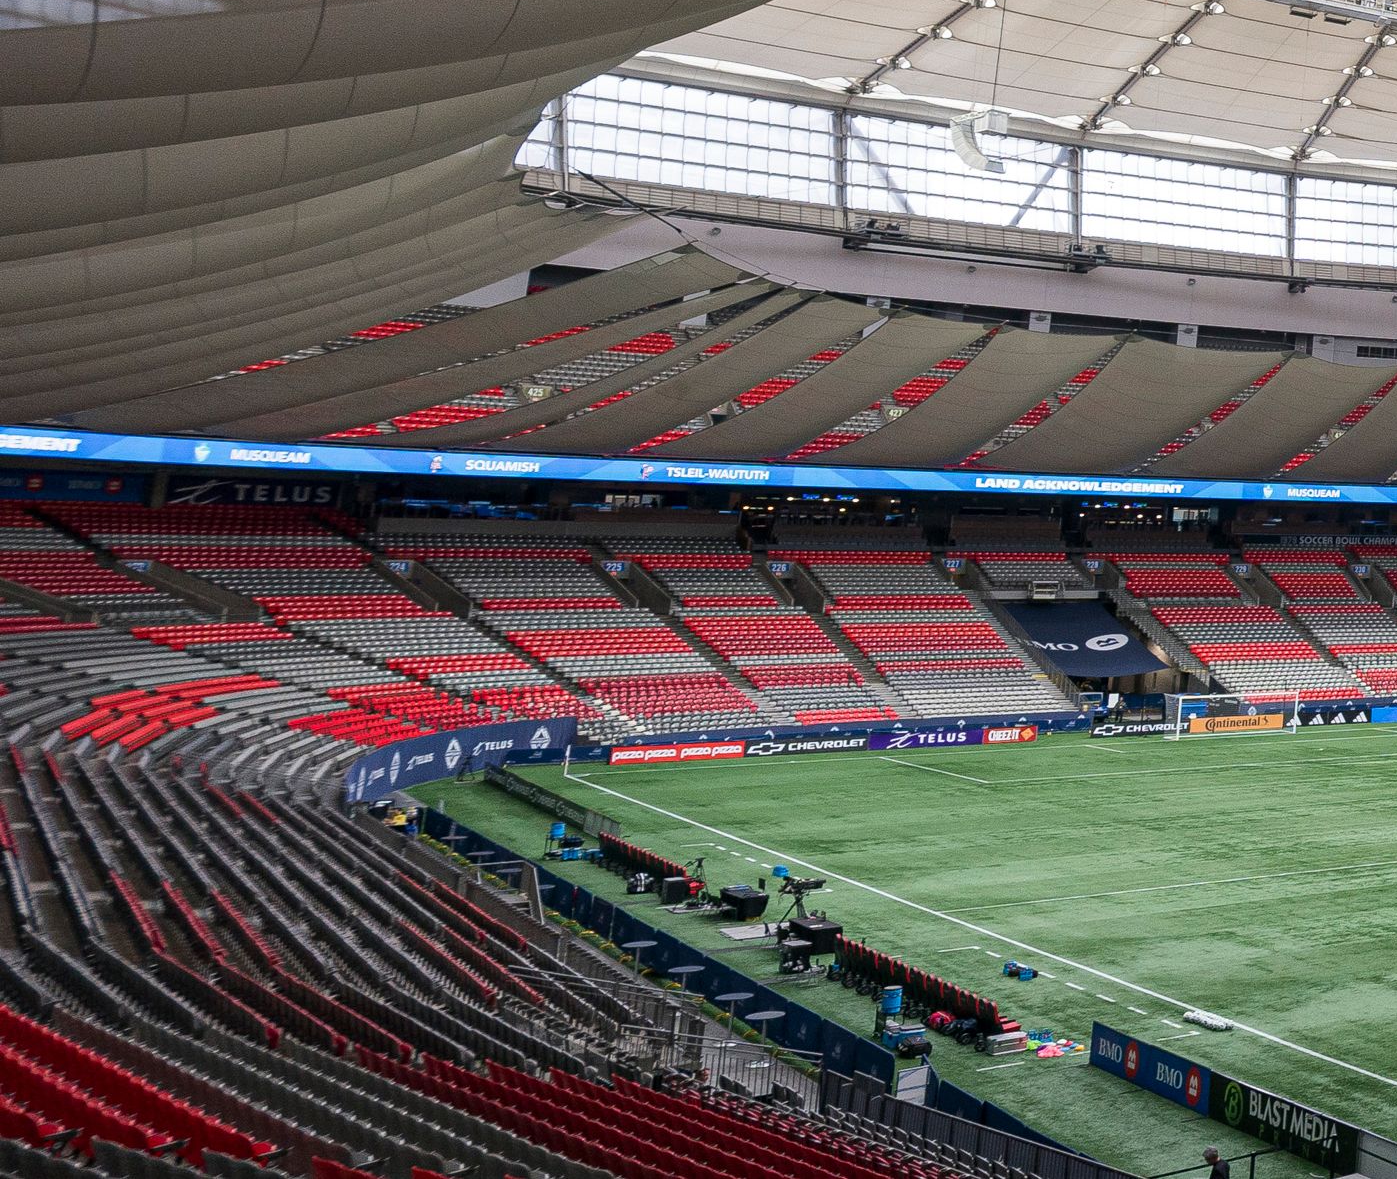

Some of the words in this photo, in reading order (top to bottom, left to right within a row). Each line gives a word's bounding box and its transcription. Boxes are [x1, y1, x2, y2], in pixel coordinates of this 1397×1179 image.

[527, 387, 544, 397] 425
[889, 408, 903, 417] 427
[230, 448, 311, 464] MUSQUEAM
[465, 459, 540, 473] SQUAMISH
[666, 466, 769, 481] TSLEIL-WAUTUTH
[976, 477, 1020, 489] LAND
[1023, 479, 1183, 494] ACKNOWLEDGEMENT
[234, 483, 332, 503] TELUS
[1287, 488, 1340, 498] MUSQUEAM
[1299, 536, 1334, 545] SOCCER
[1335, 536, 1362, 545] BOWL
[606, 562, 622, 572] 225
[772, 563, 787, 572] 226
[946, 559, 961, 568] 227
[1126, 721, 1189, 733] CHEVROLET
[1205, 716, 1261, 731] Continental
[917, 732, 967, 744] TELUS
[987, 729, 1021, 742] CHEEZ-IT
[485, 739, 514, 751] TELUS
[788, 739, 866, 752] CHEVROLET
[612, 750, 644, 763] pizza
[645, 749, 677, 761] pizza
[680, 746, 711, 759] pizza
[711, 744, 743, 757] pizza
[1098, 1038, 1122, 1063] BMO
[1155, 1062, 1183, 1089] BMO
[1249, 1090, 1290, 1130] BLAST
[1290, 1106, 1339, 1153] MEDIA
